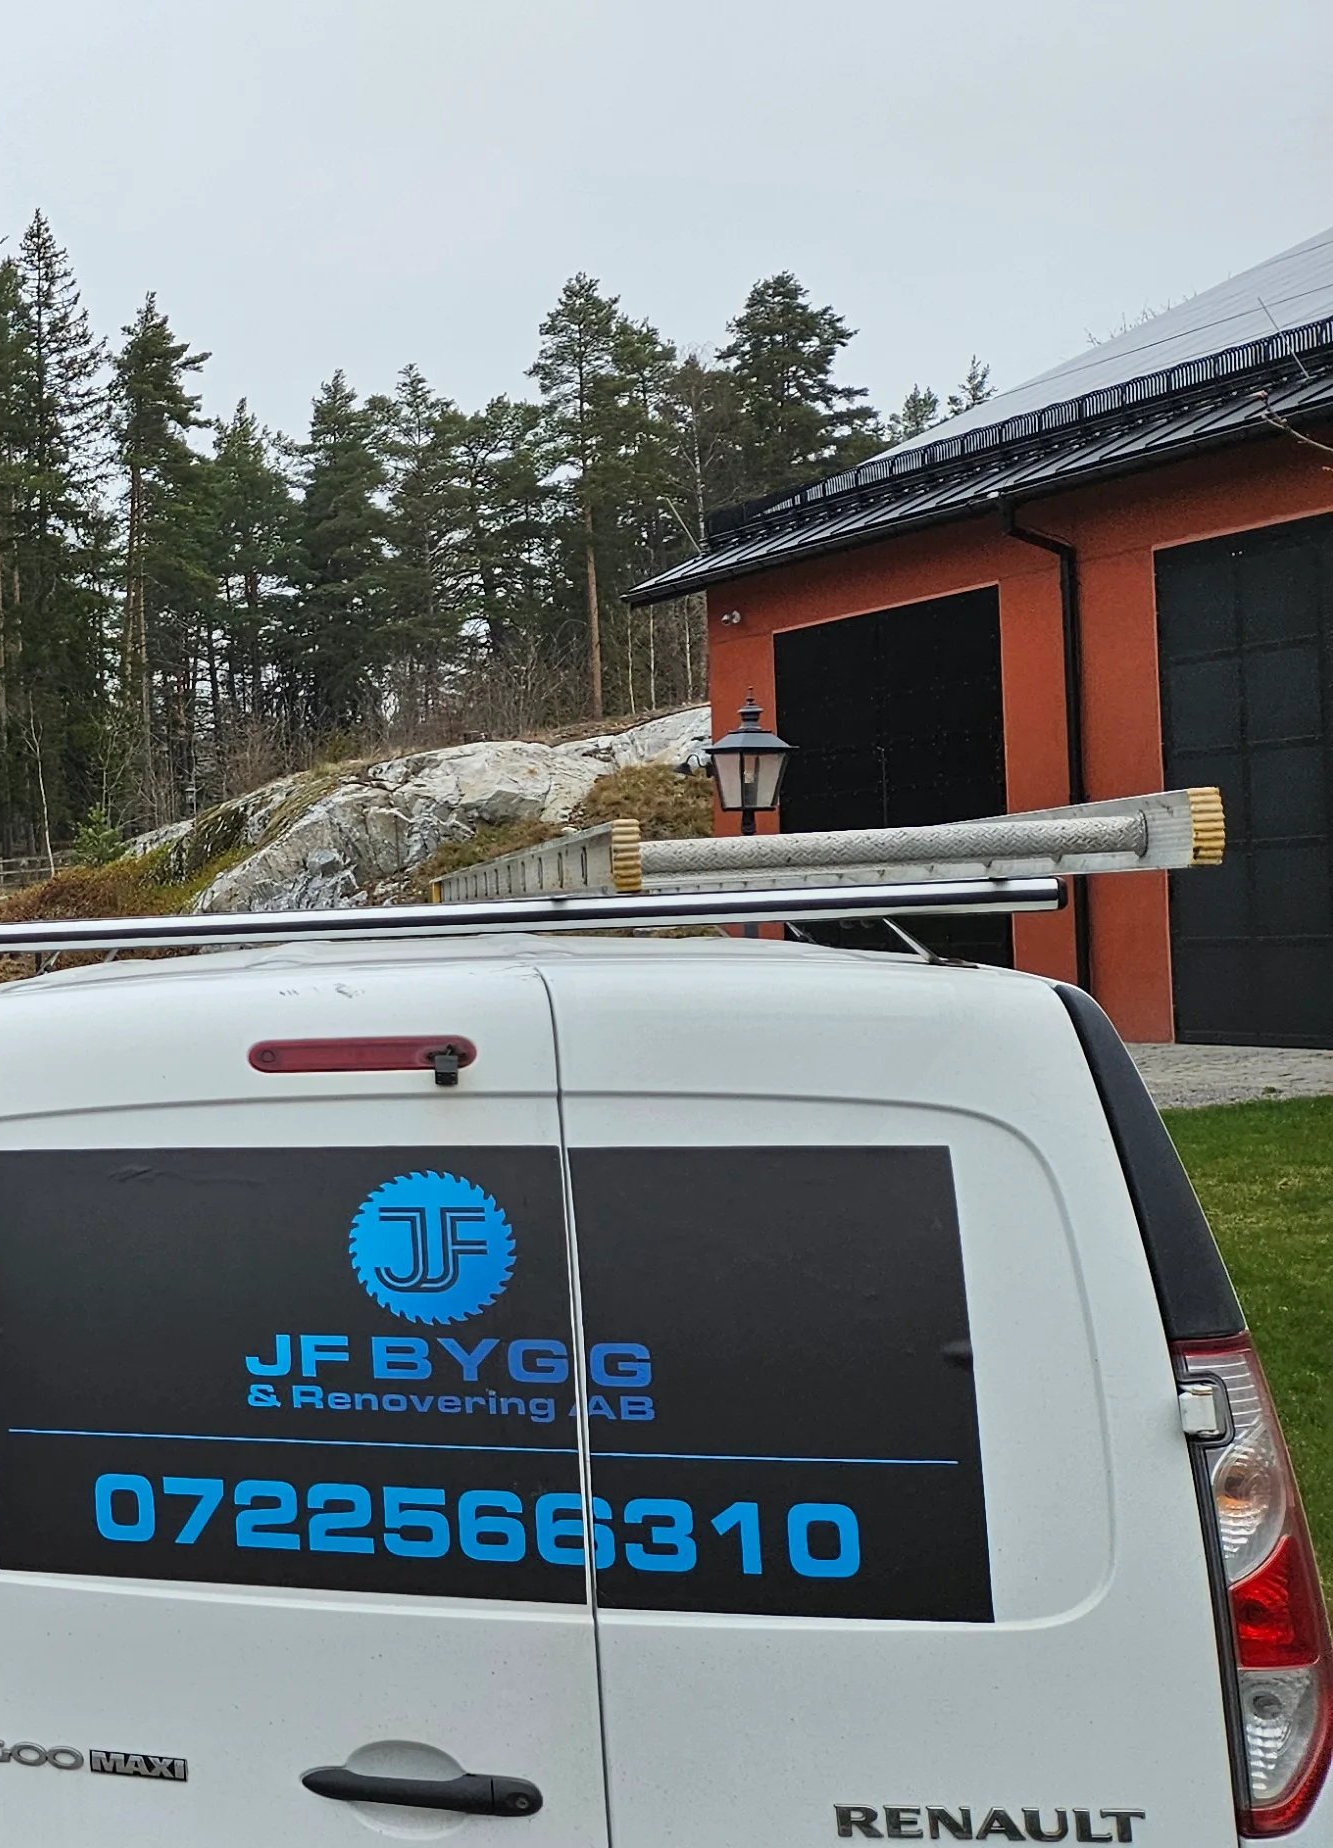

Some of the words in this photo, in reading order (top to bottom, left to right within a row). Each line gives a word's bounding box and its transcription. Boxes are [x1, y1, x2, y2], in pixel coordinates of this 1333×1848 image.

[245, 1334, 350, 1378] JF
[370, 1335, 653, 1389] BYGG
[246, 1383, 282, 1408] &
[291, 1384, 556, 1423] Renovering
[567, 1394, 656, 1421] AB
[93, 1472, 861, 1579] 0722566310
[90, 1750, 186, 1781] MAXI
[833, 1803, 1147, 1843] RENAULT
